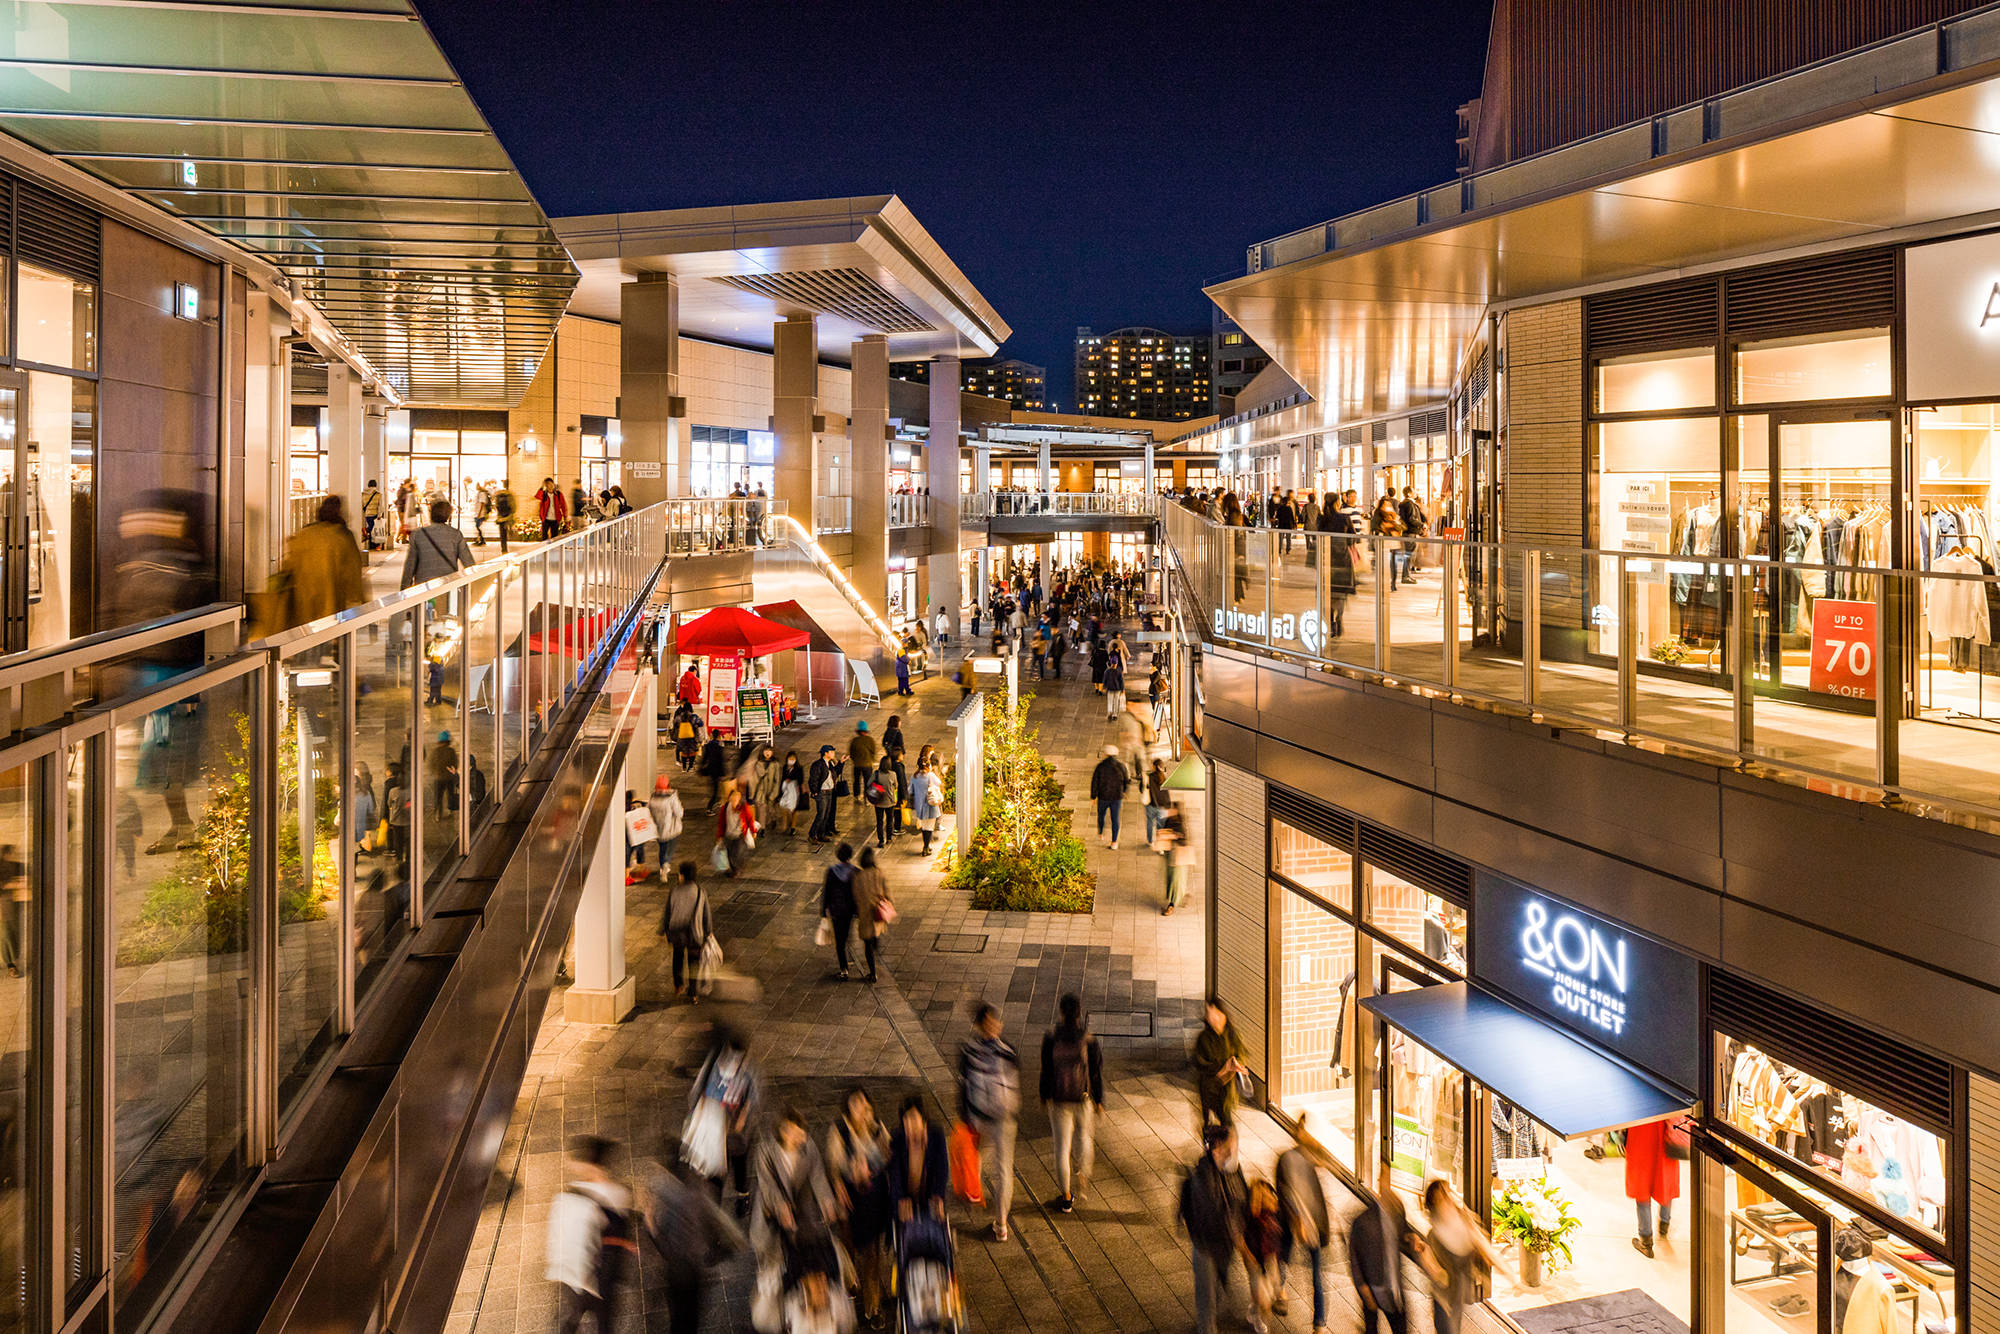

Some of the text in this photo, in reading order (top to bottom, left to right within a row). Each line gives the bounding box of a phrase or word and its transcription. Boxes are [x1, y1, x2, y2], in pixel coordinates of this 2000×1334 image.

[1834, 615, 1863, 626] UP TO
[1825, 639, 1871, 676] 70
[1522, 901, 1627, 994] &ON
[1551, 984, 1627, 1035] OUTLET
[1590, 987, 1627, 1015] STORE
